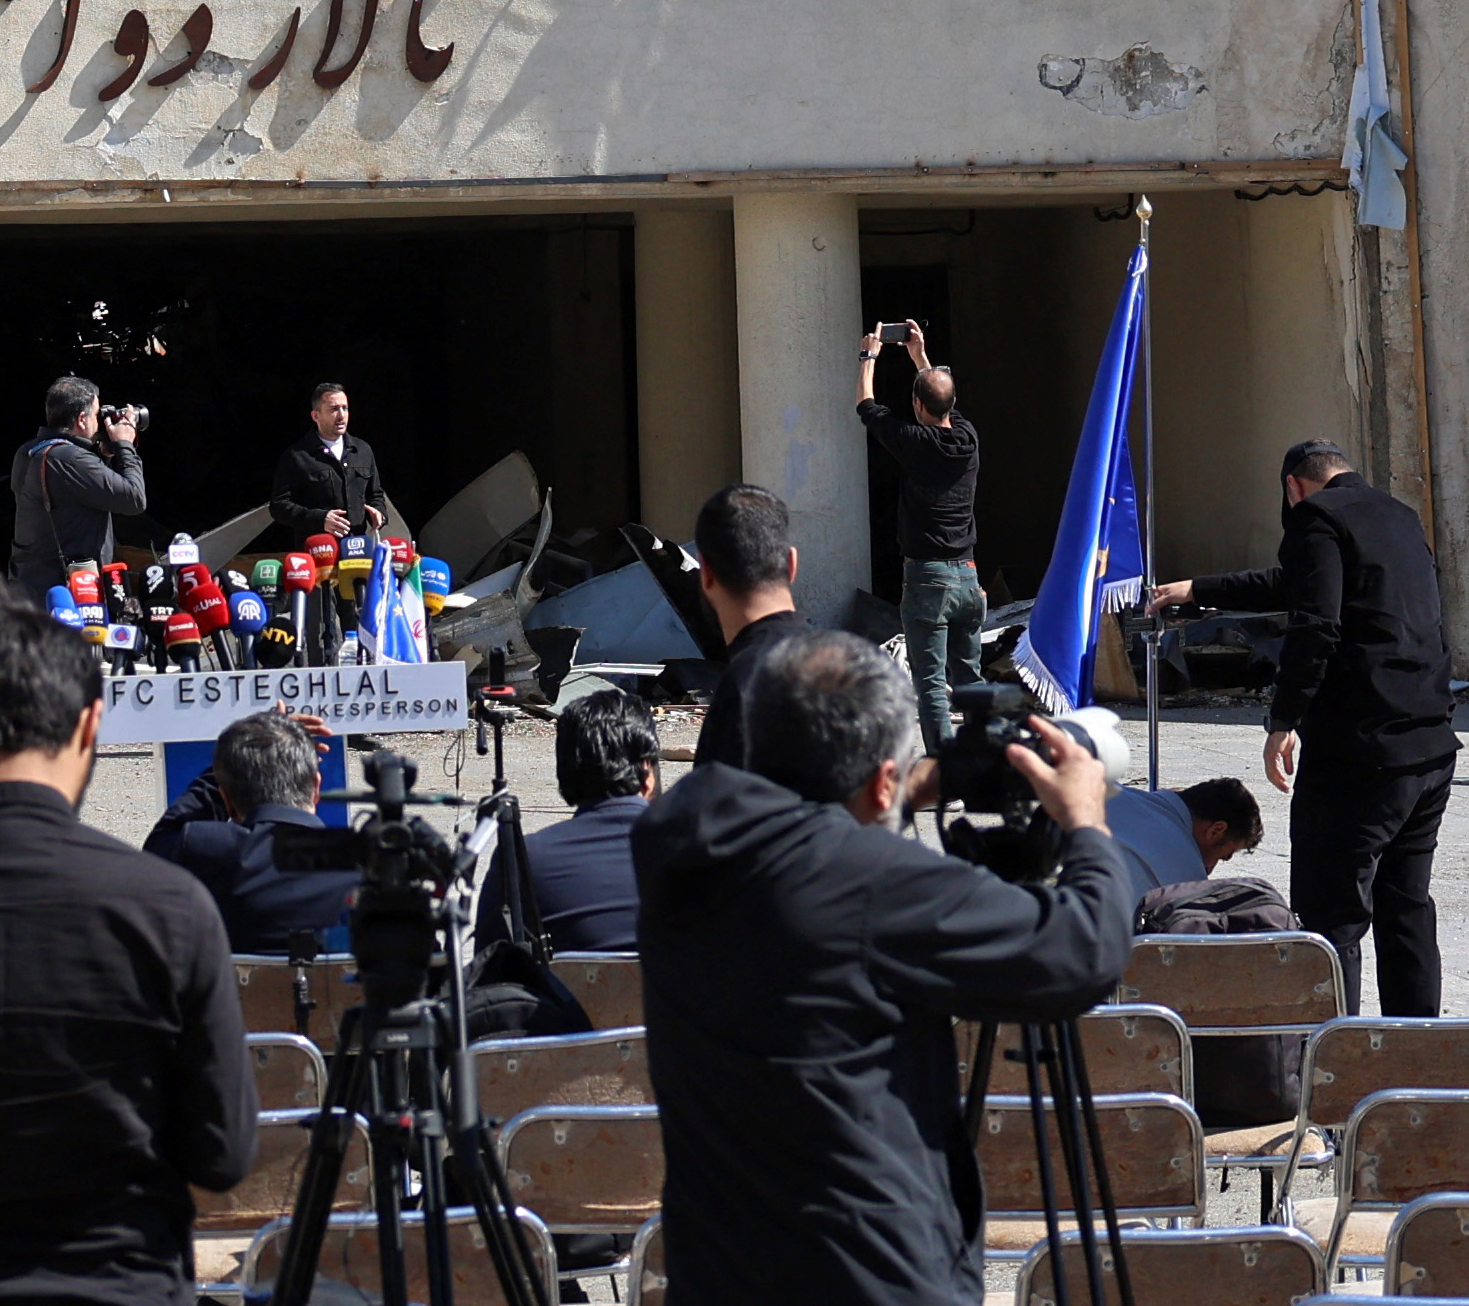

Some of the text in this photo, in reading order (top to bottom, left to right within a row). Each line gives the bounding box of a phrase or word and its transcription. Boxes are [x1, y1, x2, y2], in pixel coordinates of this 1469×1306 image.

[171, 549, 196, 558] CCTV
[150, 606, 175, 615] TRT
[261, 627, 296, 646] NTV
[112, 668, 399, 706] FC ESTEGHLAL
